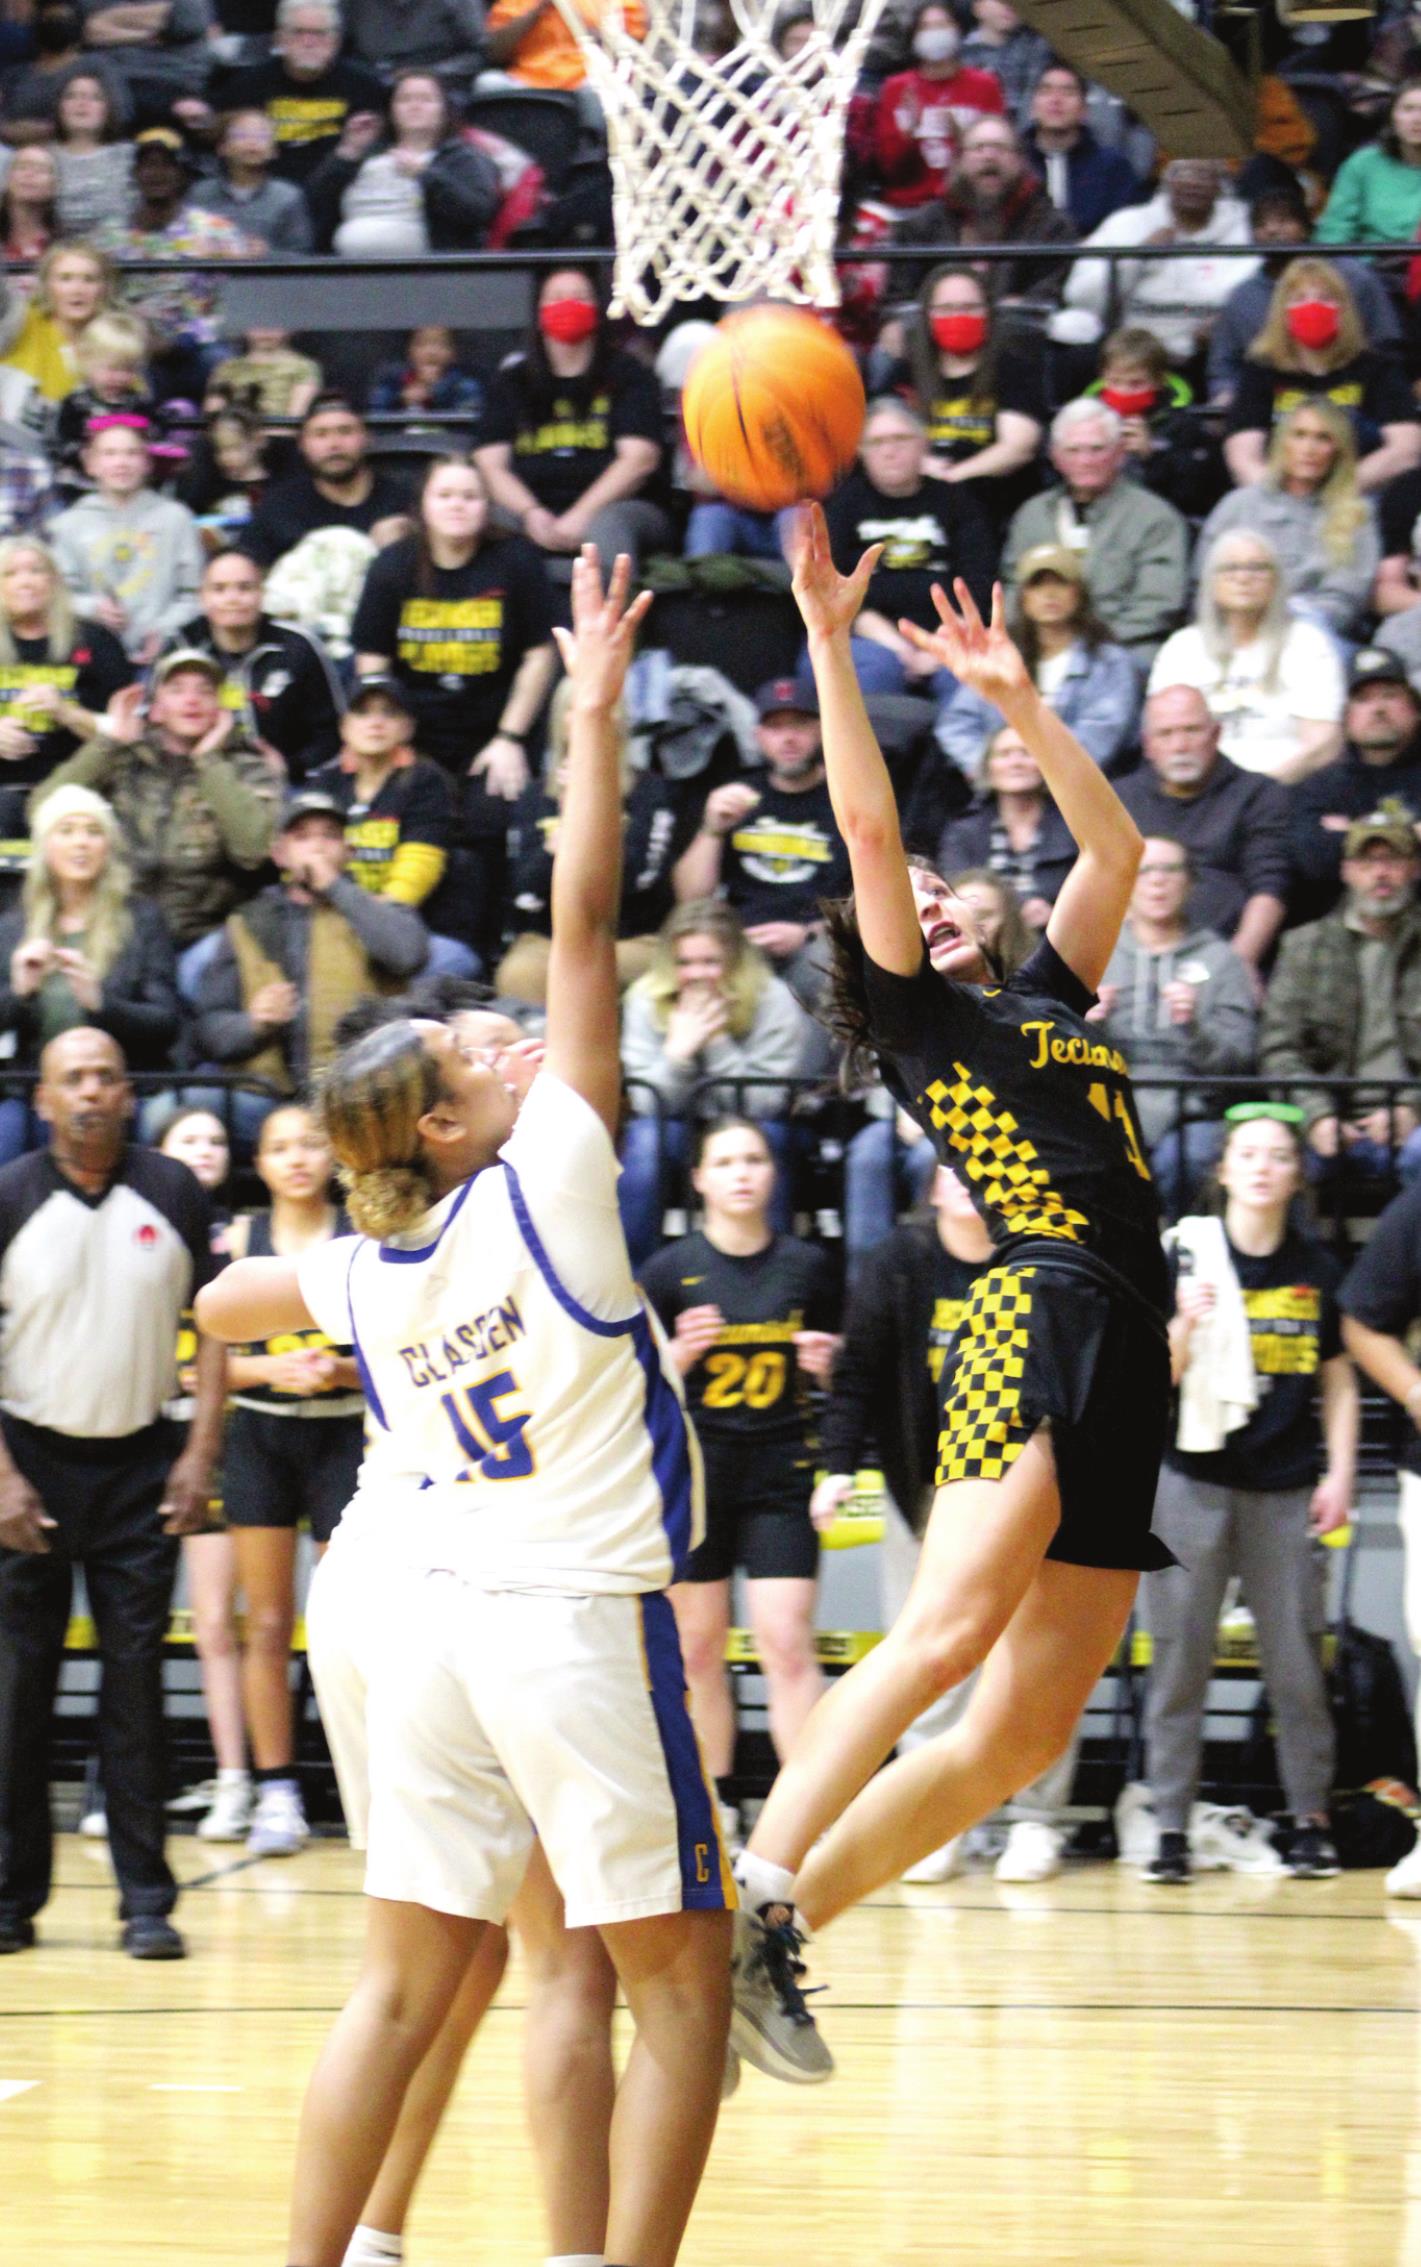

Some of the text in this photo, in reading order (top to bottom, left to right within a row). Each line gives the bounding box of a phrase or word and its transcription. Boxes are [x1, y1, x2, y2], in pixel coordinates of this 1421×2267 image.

[702, 1351, 786, 1409] 20
[438, 1368, 537, 1482] 15
[694, 1842, 711, 1883] C
